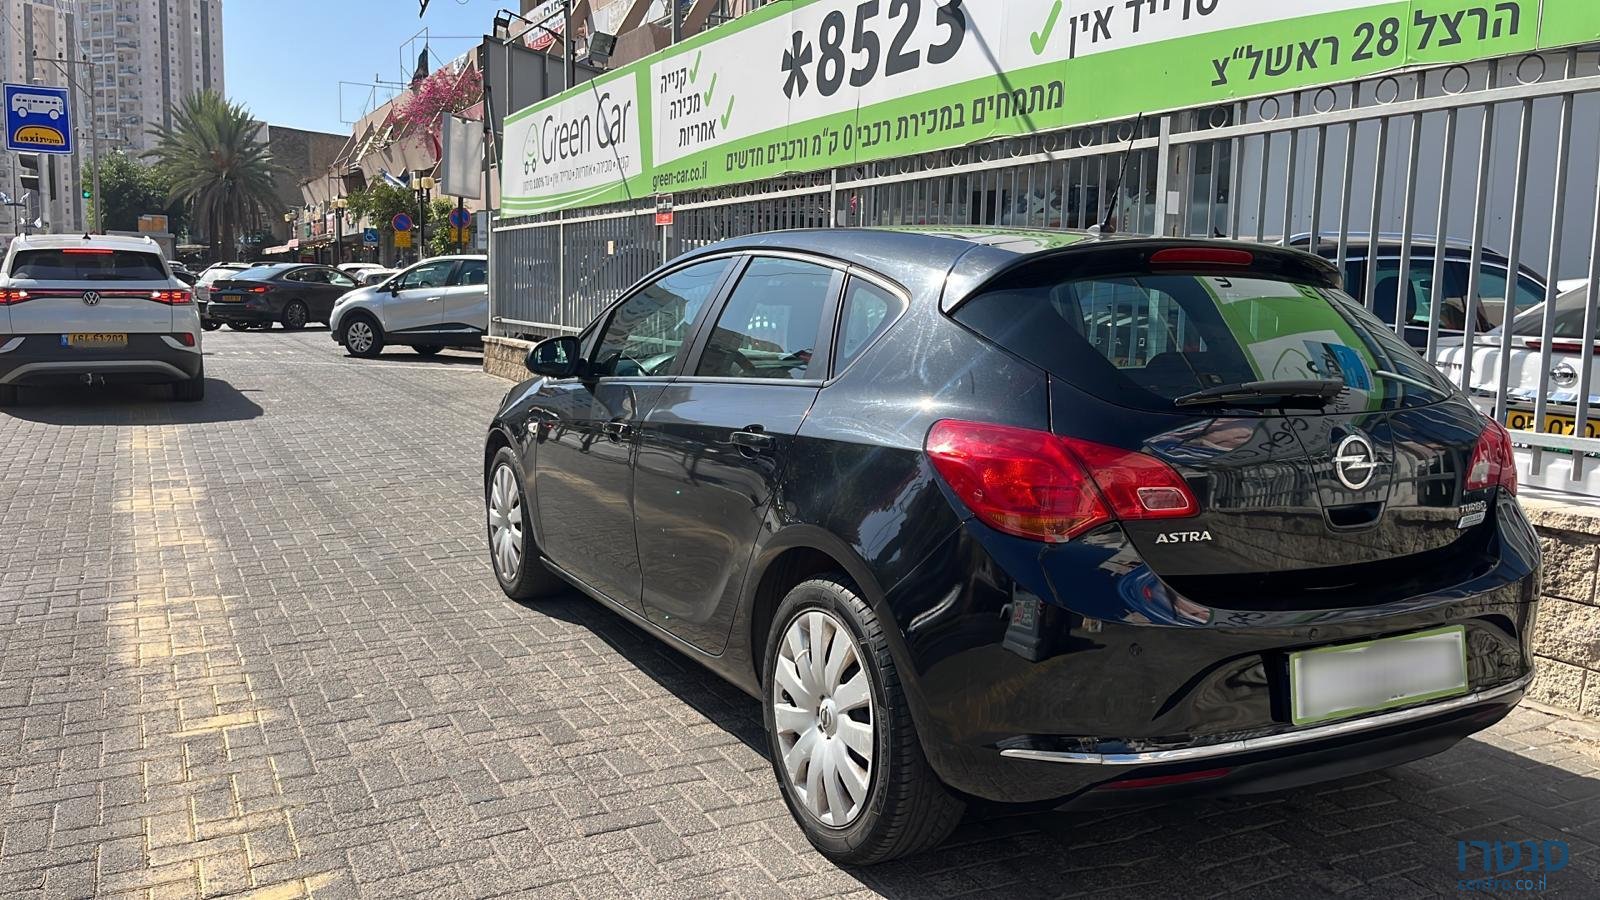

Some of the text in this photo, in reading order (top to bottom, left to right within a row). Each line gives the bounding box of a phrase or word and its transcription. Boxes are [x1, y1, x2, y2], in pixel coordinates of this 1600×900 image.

[1069, 6, 1114, 59] אין
[1351, 17, 1400, 62] 28
[1413, 2, 1521, 50] הרצל
[660, 67, 687, 94] קנייה
[669, 92, 701, 120] מכירה
[971, 80, 1064, 125] מתמחים
[541, 92, 631, 165] Green Car
[679, 118, 717, 148] אחריות
[843, 123, 853, 151] 0
[857, 120, 891, 148] רכבי
[895, 103, 965, 141] במכירת
[726, 146, 764, 172] חדשים
[767, 137, 808, 164] ורכבים
[652, 160, 708, 192] green-car.co.il
[1155, 530, 1213, 544] ASTRA
